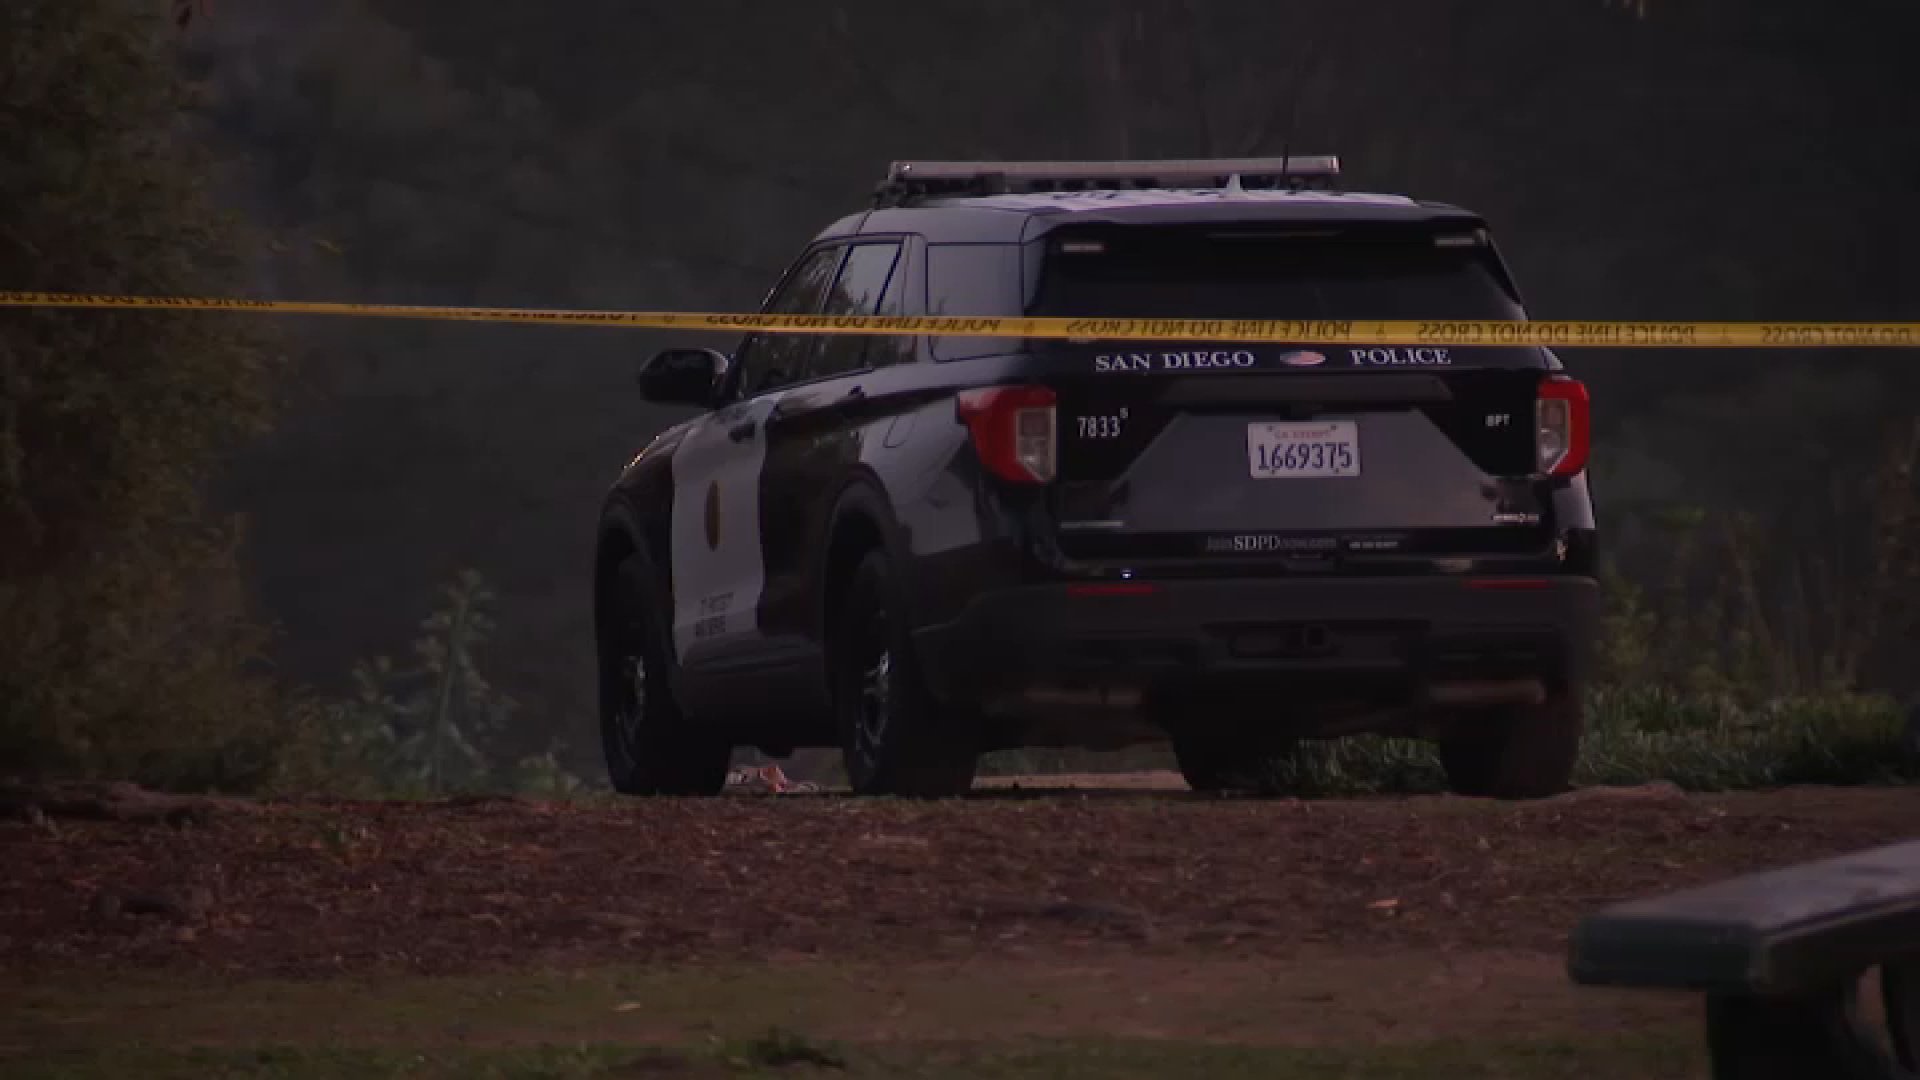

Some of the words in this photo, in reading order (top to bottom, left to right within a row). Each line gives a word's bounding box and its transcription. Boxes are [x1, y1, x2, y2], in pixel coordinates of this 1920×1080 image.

[1094, 353, 1151, 373] SAN
[1161, 350, 1256, 369] DIEGO
[1348, 347, 1452, 365] POLICE
[1257, 441, 1352, 471] 1669375
